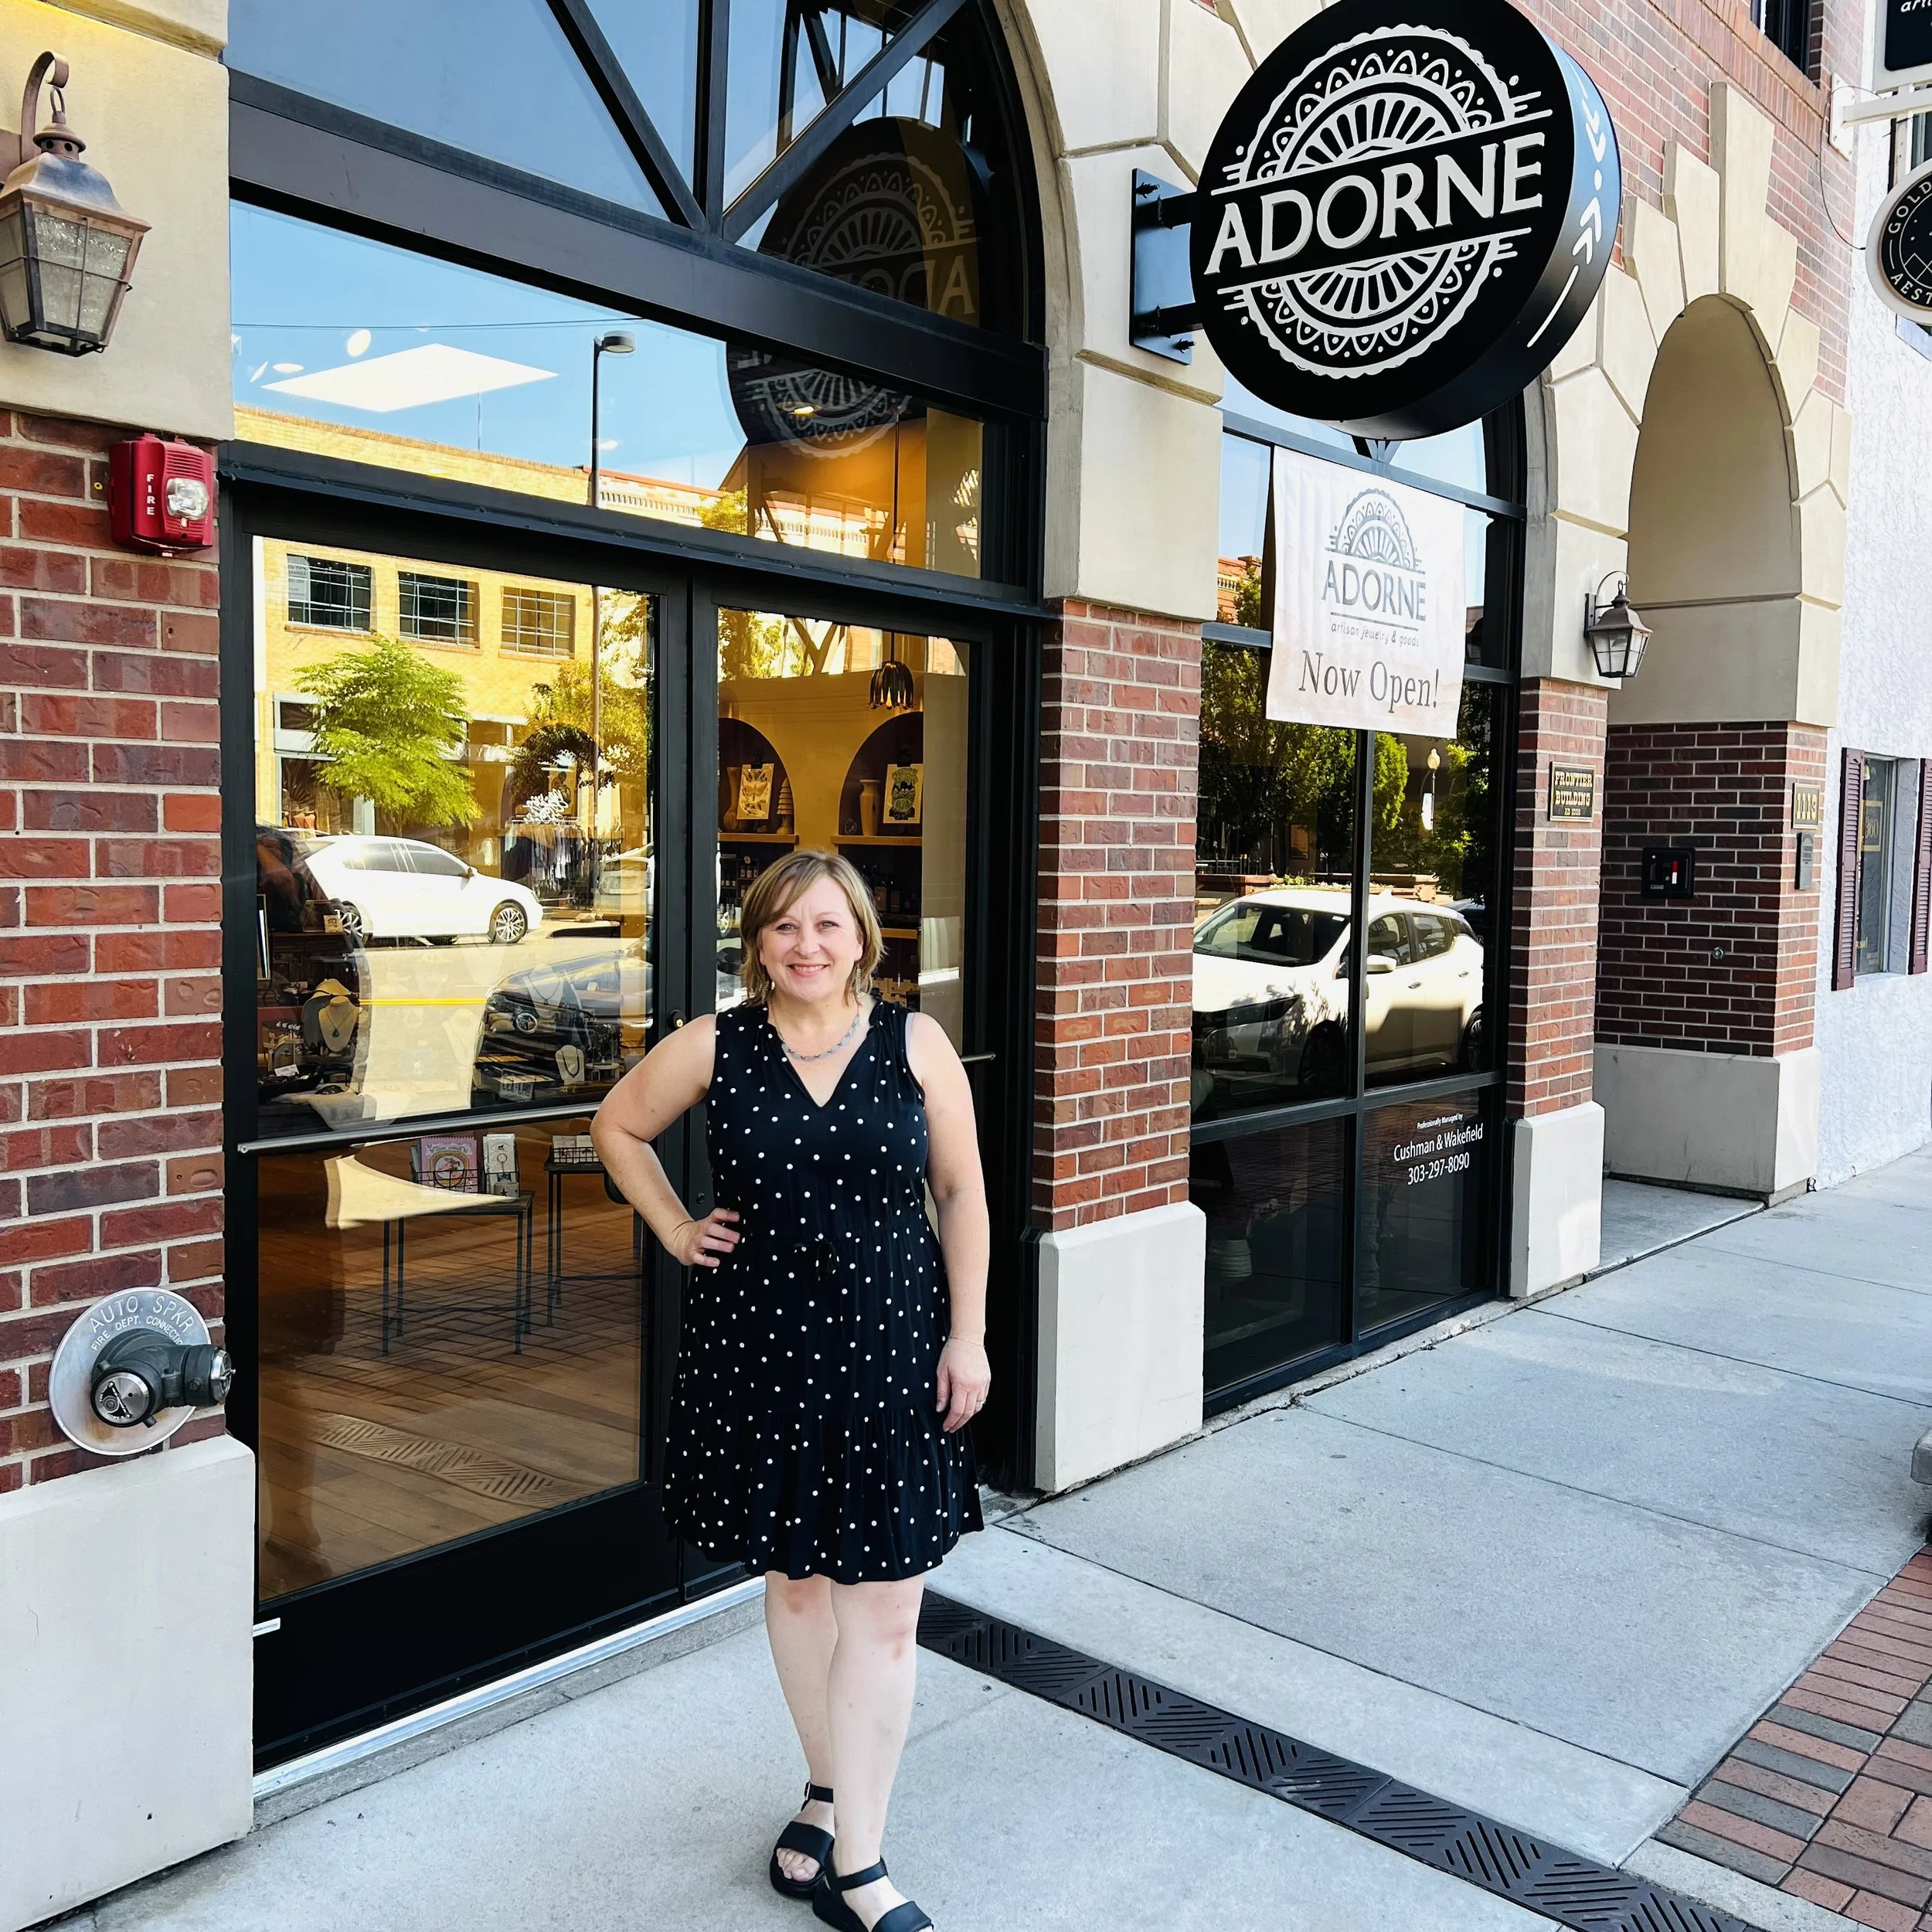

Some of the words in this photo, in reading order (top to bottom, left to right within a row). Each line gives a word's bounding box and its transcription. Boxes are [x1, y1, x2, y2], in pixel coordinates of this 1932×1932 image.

[1204, 131, 1546, 275] ADORNE
[146, 474, 155, 515] FIRE
[1321, 560, 1427, 621] ADORNE
[1331, 622, 1359, 636] artisan
[1360, 627, 1389, 645] jewelry
[1391, 630, 1397, 644] &
[1399, 635, 1420, 648] goods
[1298, 649, 1361, 698] Now
[1370, 661, 1440, 714] Open!
[1554, 770, 1593, 787] FRONTIER
[1555, 790, 1590, 807] BUILDING
[1796, 792, 1818, 821] 1113
[1417, 1117, 1441, 1130] Professionally
[1442, 1113, 1458, 1124] Managed
[1393, 1141, 1435, 1162] Cushman
[1437, 1134, 1444, 1151] &
[1444, 1123, 1484, 1148] Wakefield
[1407, 1151, 1470, 1185] 303-297-8090
[152, 1295, 195, 1333] SPKR
[91, 1330, 111, 1352] FIRE
[146, 1315, 184, 1345] CONNECTIO
